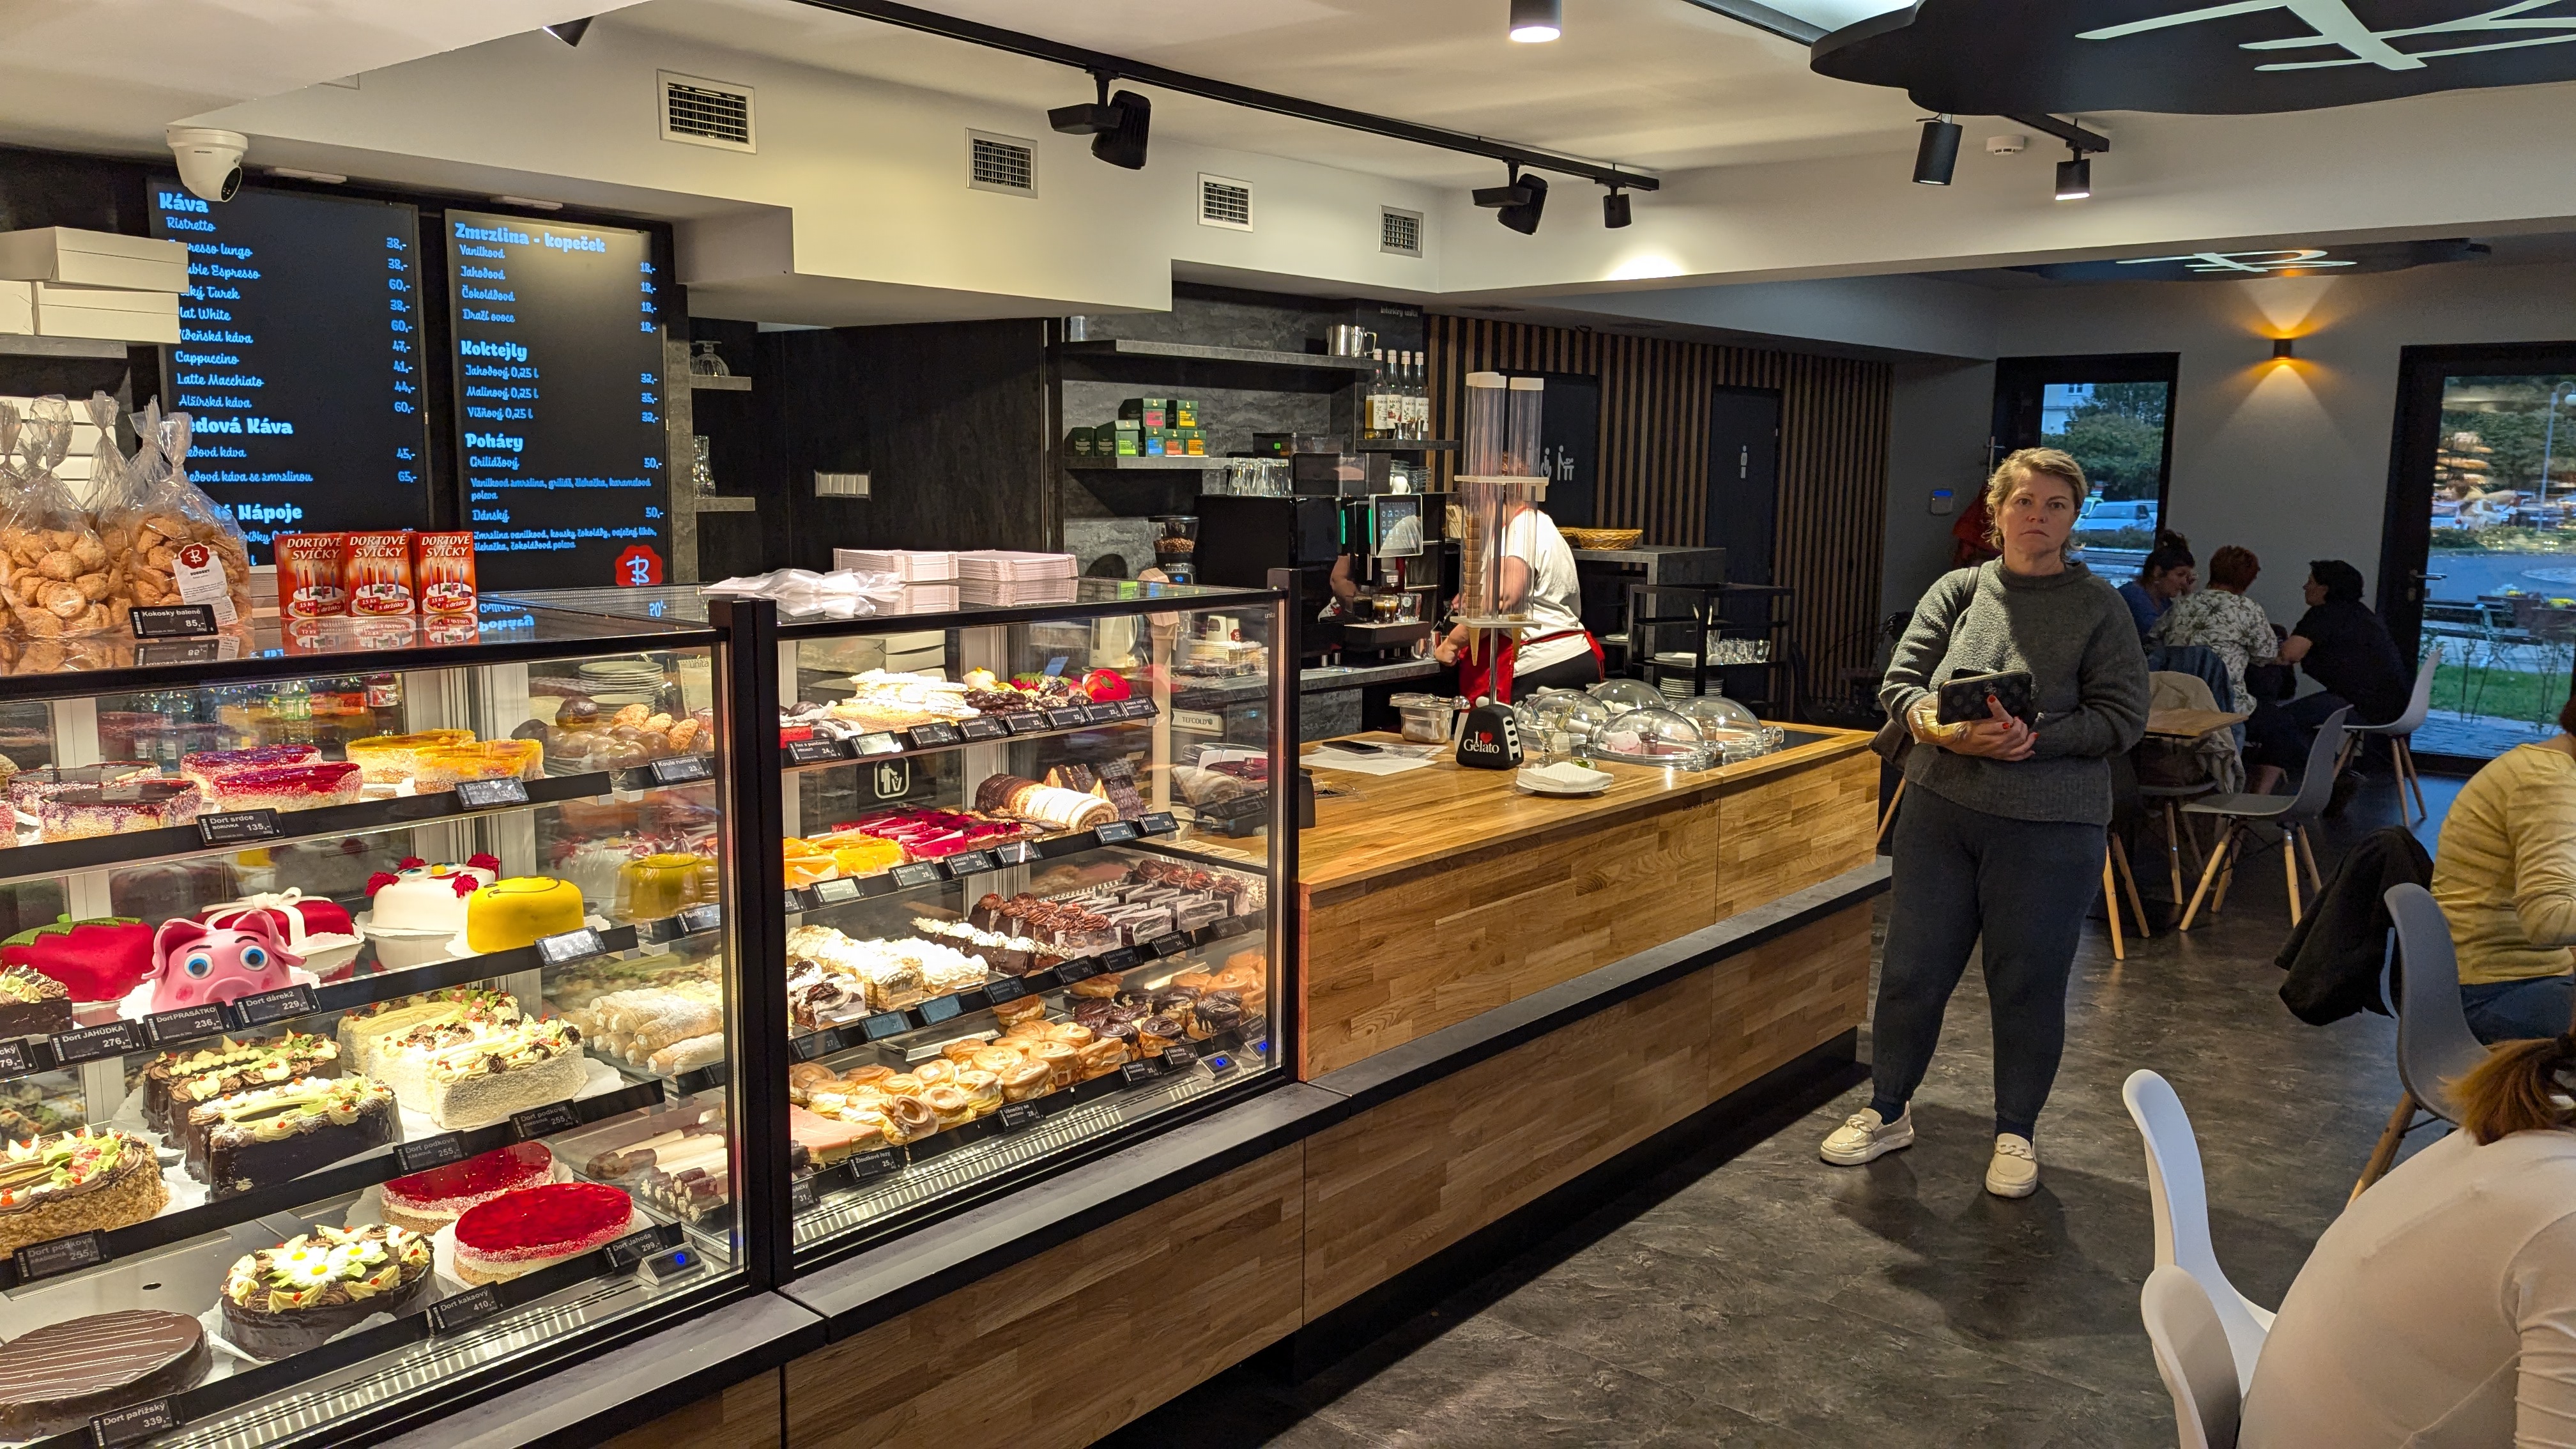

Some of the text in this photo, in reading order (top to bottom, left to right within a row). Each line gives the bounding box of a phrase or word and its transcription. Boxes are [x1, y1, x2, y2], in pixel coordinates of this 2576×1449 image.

[159, 193, 209, 213] Káva
[166, 217, 216, 232] Ristretto
[387, 238, 406, 250] 38,-
[455, 223, 529, 245] Zmrzlina
[544, 233, 606, 252] kopeček
[221, 243, 253, 259] lungo
[459, 245, 505, 259] Vanilková
[388, 258, 408, 271] 38,-
[640, 263, 656, 274] 18,-
[187, 263, 261, 280] uble Espresso
[461, 266, 505, 280] Jahodová
[389, 279, 410, 291] 60,-
[641, 282, 657, 293] 18,-
[206, 286, 240, 299] Turek
[462, 285, 516, 302] Čokoládová
[390, 300, 410, 312] 38,-
[641, 302, 657, 313] 18,-
[179, 307, 232, 321] lat White
[463, 309, 516, 323] Dračí ovoce
[392, 320, 413, 332] 60,-
[641, 322, 657, 333] 18,-
[225, 331, 254, 343] káva
[461, 341, 528, 362] Koktejly
[175, 351, 240, 366] Cappuccino
[394, 360, 413, 373] 41,-
[465, 364, 509, 380] Jahodový
[511, 367, 532, 379] 0,25
[177, 373, 264, 387] Latte Macchiato
[395, 381, 415, 393] 44,-
[466, 386, 509, 400] Malinový
[511, 387, 532, 399] 0,25
[179, 395, 252, 408] Alžírská káva
[395, 402, 415, 413] 60,-
[468, 406, 504, 420] Višňový
[505, 408, 527, 419] 0,25
[191, 417, 294, 434] edová Káva
[465, 433, 523, 452] Poháry
[186, 445, 247, 457] edová káva
[397, 448, 416, 459] 45,-
[644, 457, 662, 469] 50,-
[222, 471, 248, 482] káva
[249, 473, 259, 482] se
[262, 471, 313, 482] zmrzlinou
[398, 471, 417, 482] 65,-
[471, 491, 498, 502] poleva
[238, 503, 303, 523] Nápoje
[472, 509, 509, 523] Dánský
[645, 507, 663, 518] 50,-
[349, 533, 407, 546] DORTOVÉ
[422, 533, 470, 546] DORTOVÉ
[1463, 730, 1499, 754] I Gelato
[246, 991, 294, 1007] Dort dárek2
[282, 1000, 306, 1010] 229,-
[173, 1007, 215, 1020] PRASÁTKO
[194, 1018, 220, 1029] 236,-
[63, 1025, 124, 1043] Dort JAHŮDKA
[102, 1037, 130, 1048] 276,-
[521, 1107, 566, 1122] Dort podkova
[405, 1138, 455, 1154] Dort podkova
[27, 1238, 93, 1257] Dort podkova
[613, 1234, 652, 1252] Dort Jahoda
[641, 1242, 660, 1252] 299,-
[440, 1289, 488, 1312] Dort kakaový
[473, 1300, 495, 1310] 410,-
[103, 1414, 125, 1425] Dort
[144, 1416, 170, 1428] 339,-
